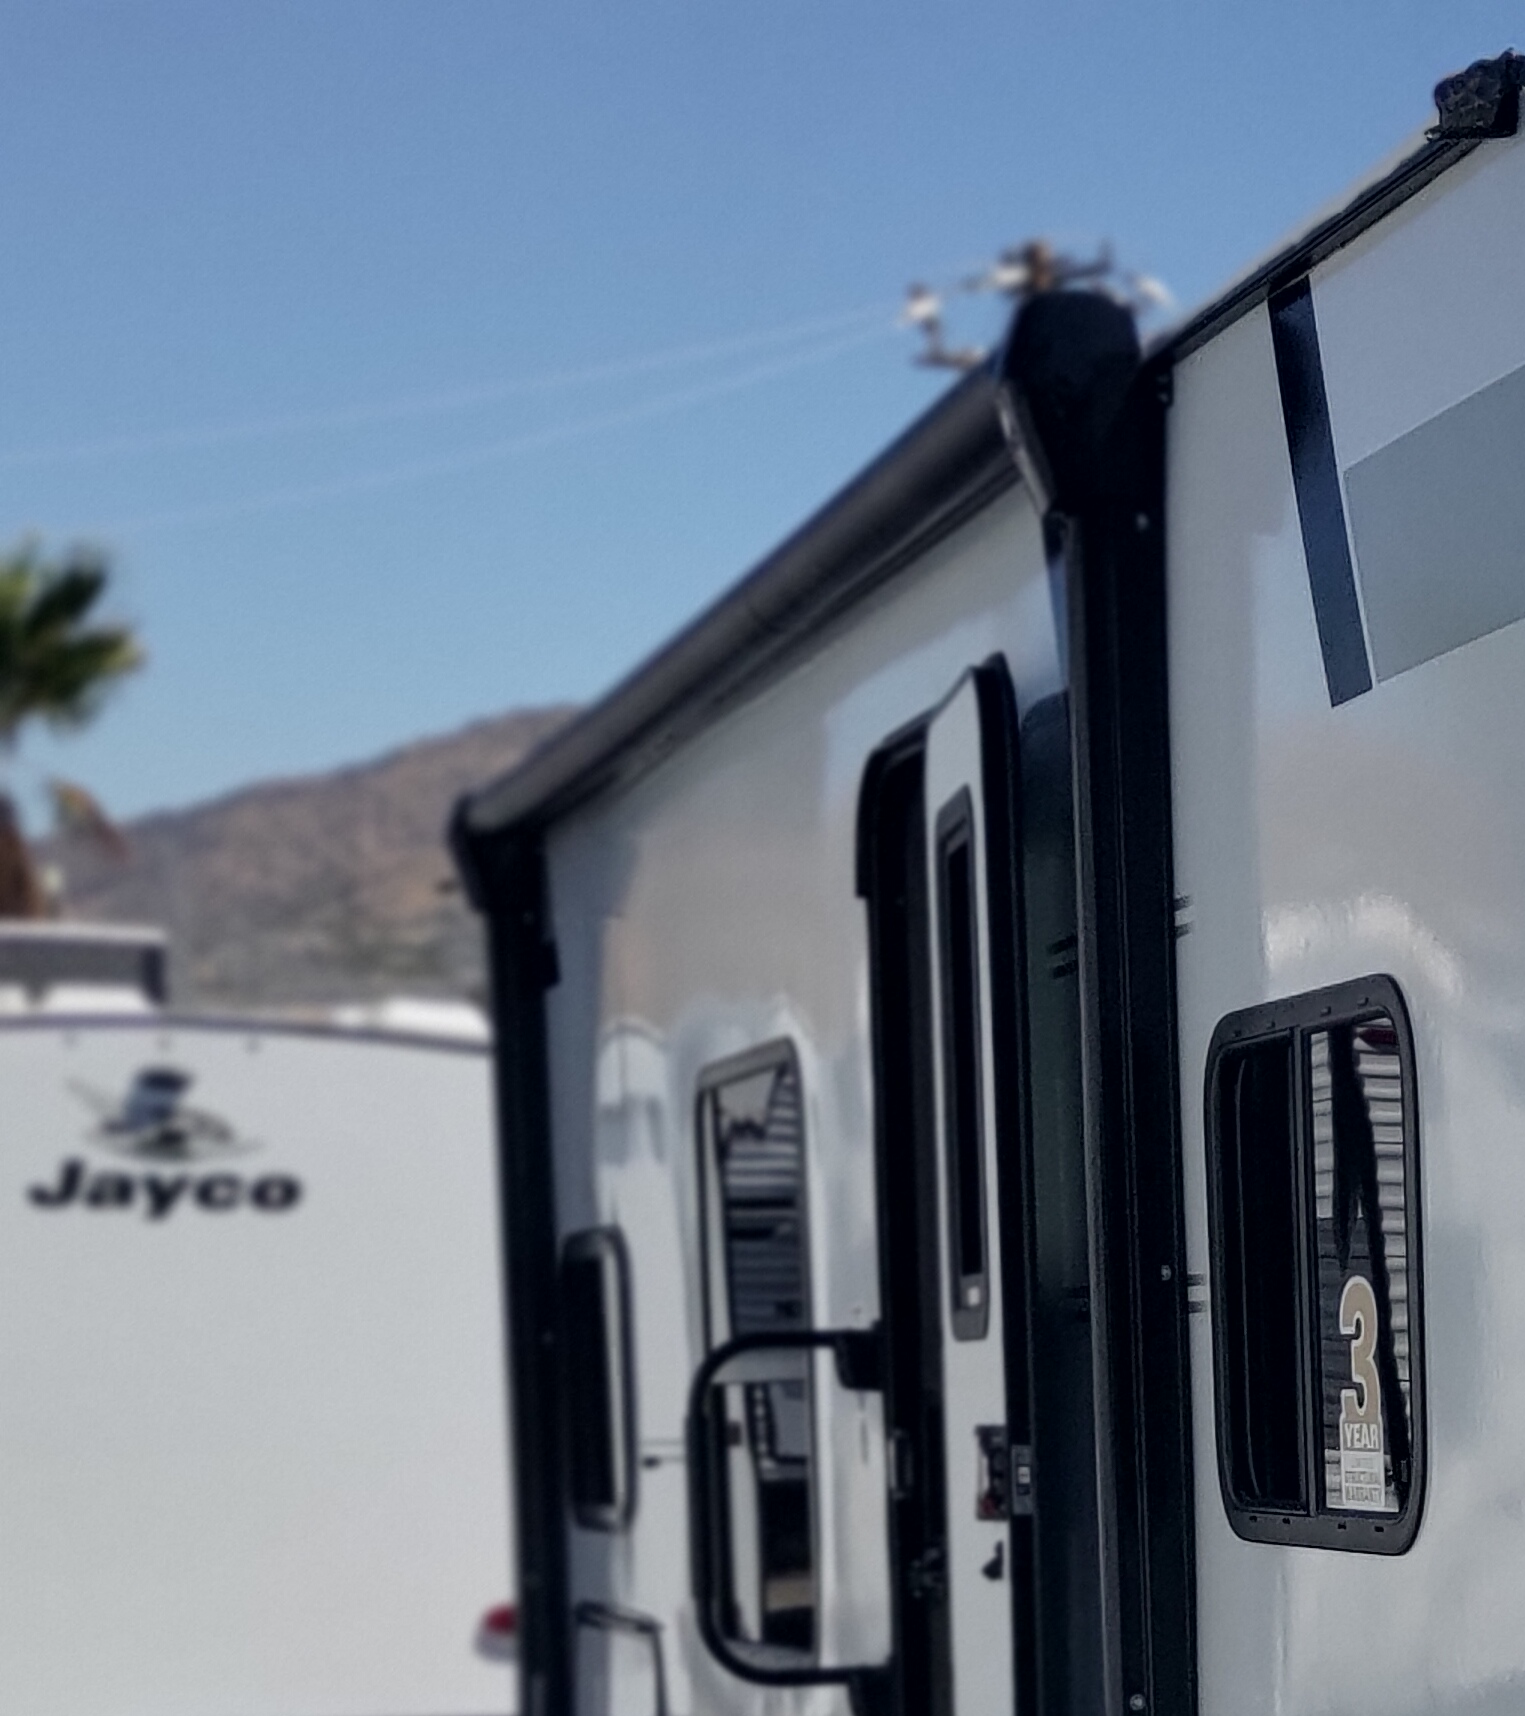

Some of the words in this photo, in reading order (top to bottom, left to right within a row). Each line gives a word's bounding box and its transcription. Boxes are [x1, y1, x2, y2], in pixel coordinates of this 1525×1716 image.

[27, 1157, 304, 1223] Jayco
[1339, 1275, 1380, 1418] 3
[1344, 1422, 1379, 1449] YEAR
